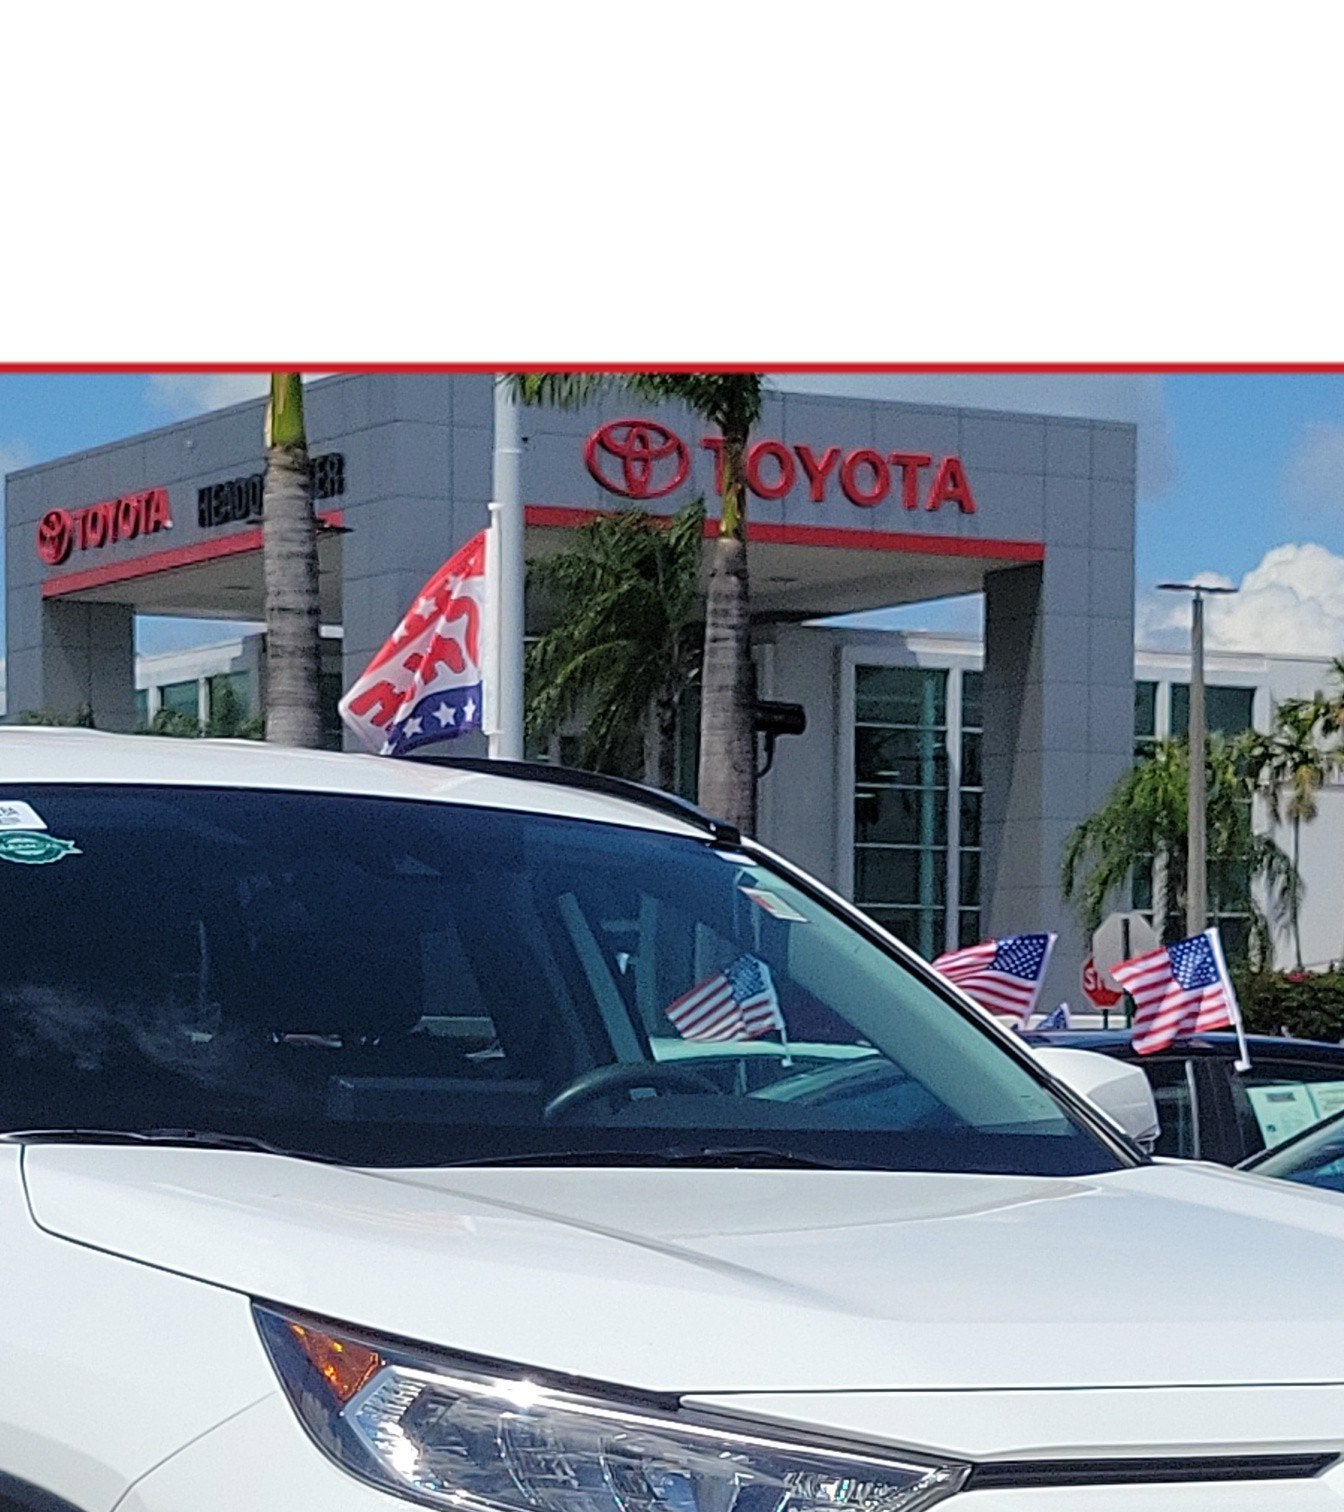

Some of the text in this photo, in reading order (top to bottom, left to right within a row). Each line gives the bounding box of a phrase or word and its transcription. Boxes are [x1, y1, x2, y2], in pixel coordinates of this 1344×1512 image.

[197, 452, 345, 528] HEADQER
[701, 437, 977, 514] TOYOTA
[70, 486, 169, 550] TOYOTA
